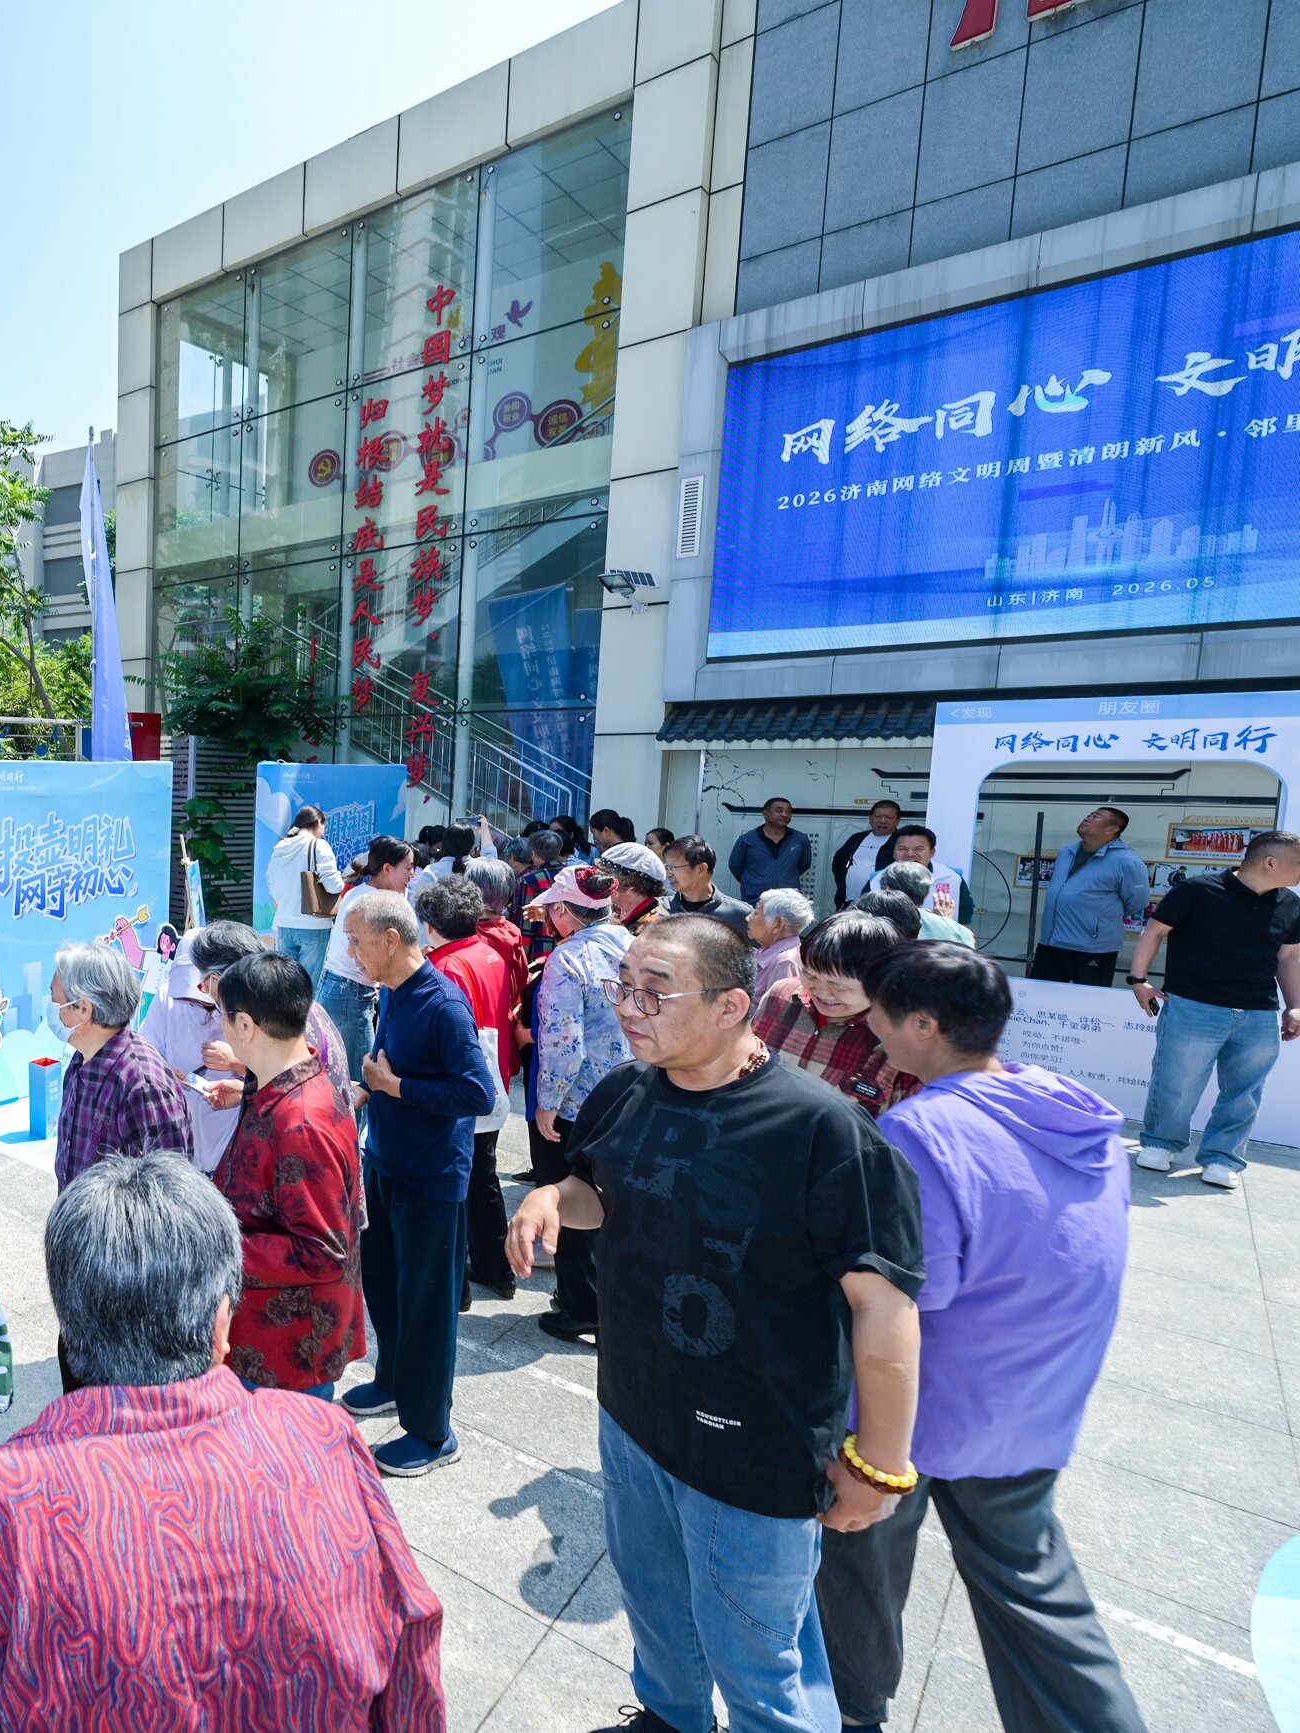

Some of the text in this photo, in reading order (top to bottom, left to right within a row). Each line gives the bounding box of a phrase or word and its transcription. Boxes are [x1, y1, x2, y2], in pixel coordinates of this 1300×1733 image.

[780, 368, 1112, 464] 网络同心
[350, 397, 389, 712] 归根结底是人民梦
[1112, 576, 1215, 595] 2026.05
[960, 699, 1160, 719] 发现 朋友圈
[994, 724, 1279, 754] 网络同心 文明同行
[12, 862, 136, 921] 网守初心
